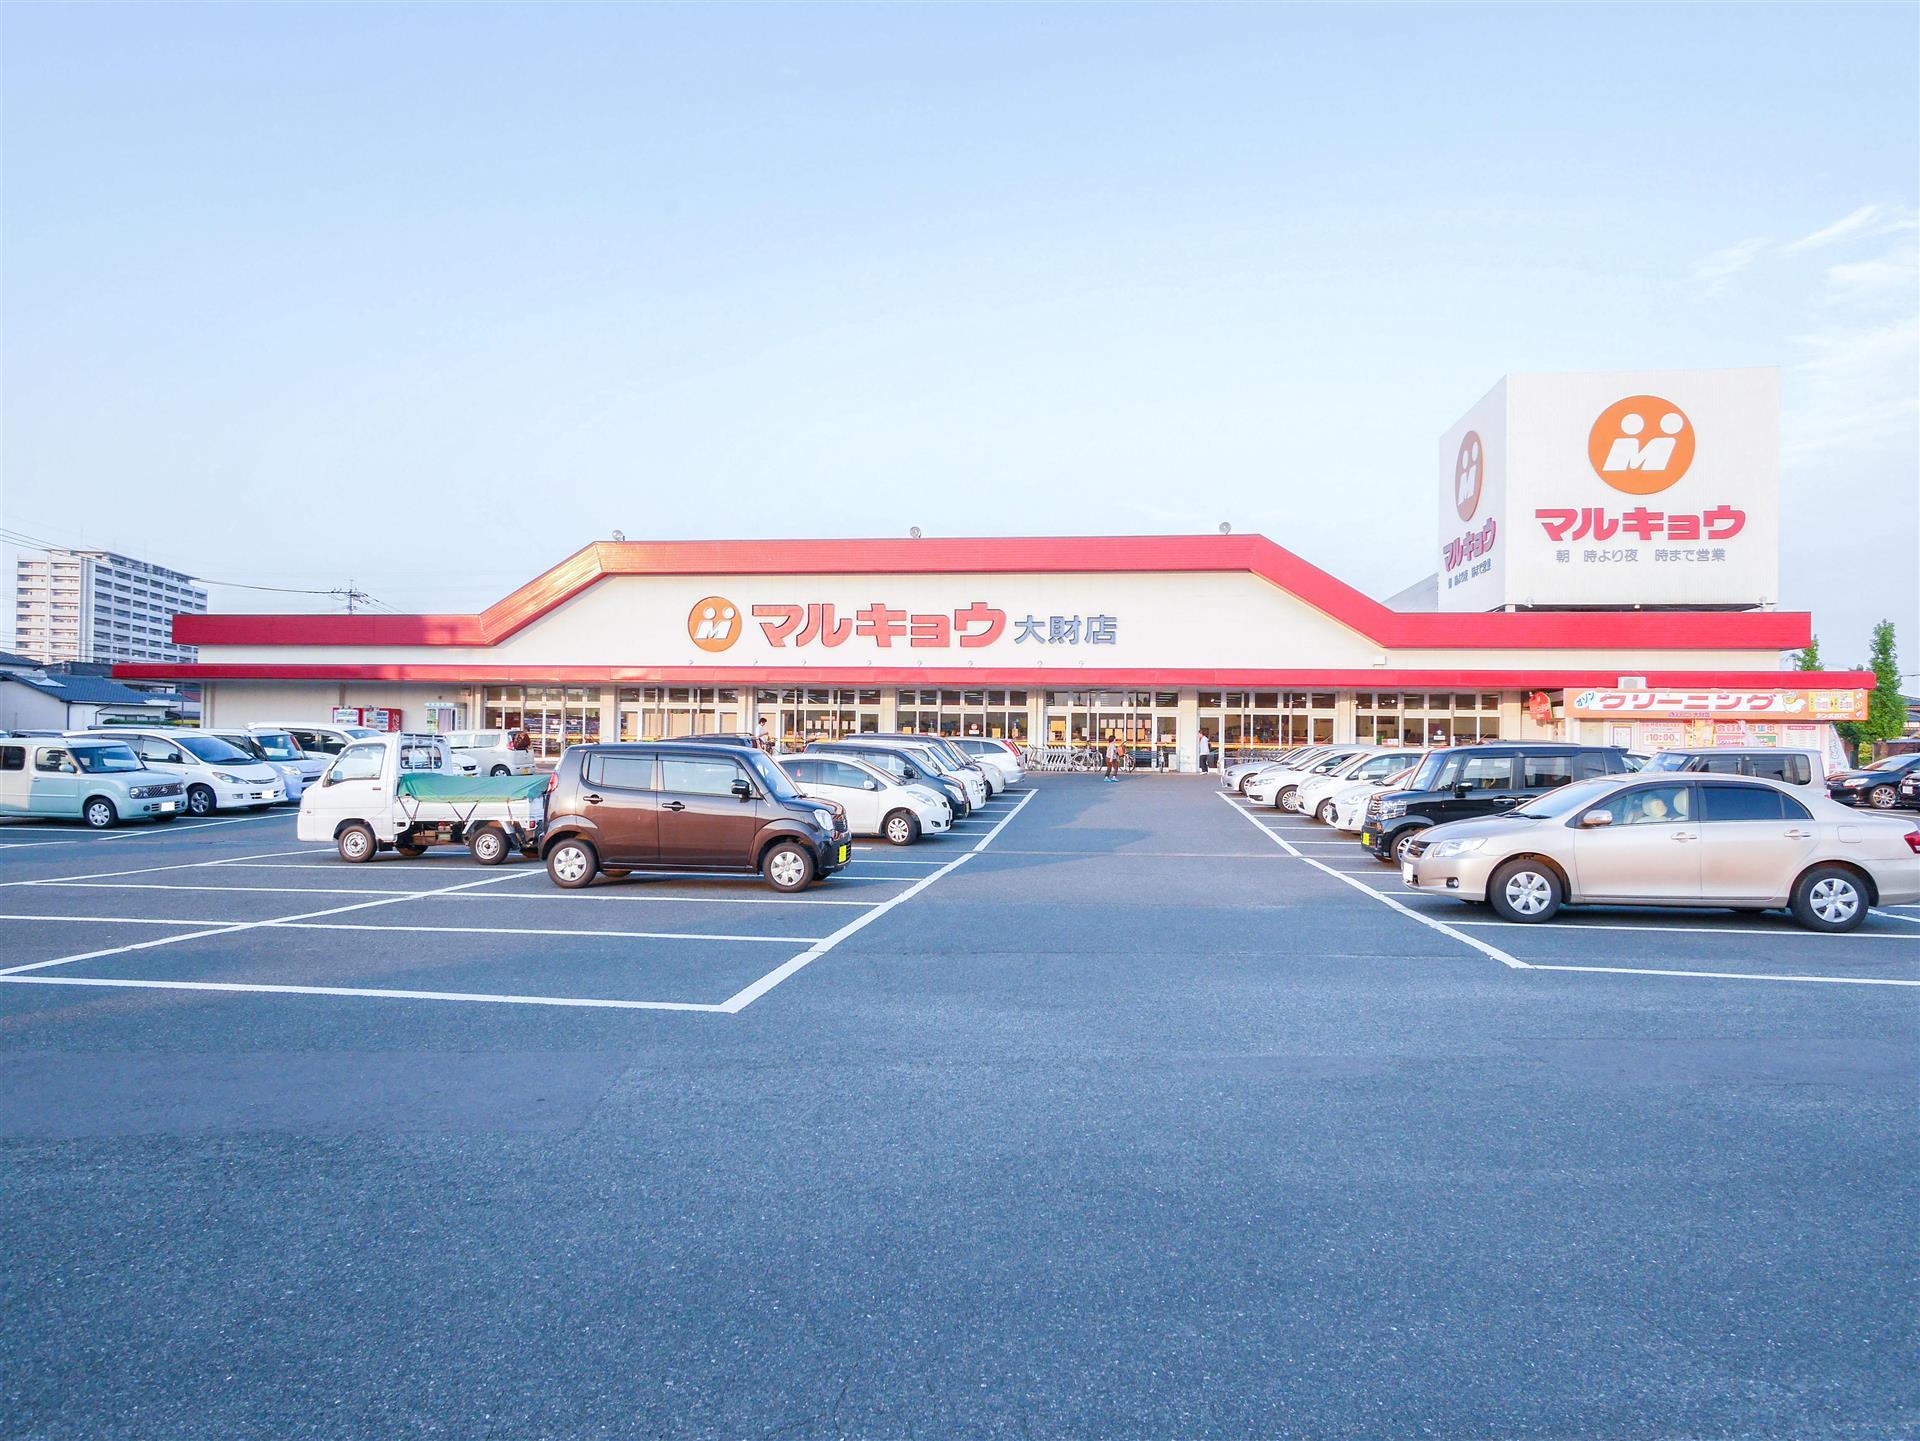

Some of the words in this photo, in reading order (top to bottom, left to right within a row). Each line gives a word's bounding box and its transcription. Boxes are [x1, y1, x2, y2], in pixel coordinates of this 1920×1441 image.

[1535, 505, 1746, 541] マルキョウ
[1442, 517, 1496, 572] マルキョウ
[1556, 549, 1569, 563] 朝
[1583, 549, 1639, 563] 時より夜
[1655, 548, 1726, 562] 時まで営業
[751, 602, 1007, 648] マルキョウ
[1013, 615, 1118, 645] 大財店
[1600, 693, 1776, 710] クリーニング
